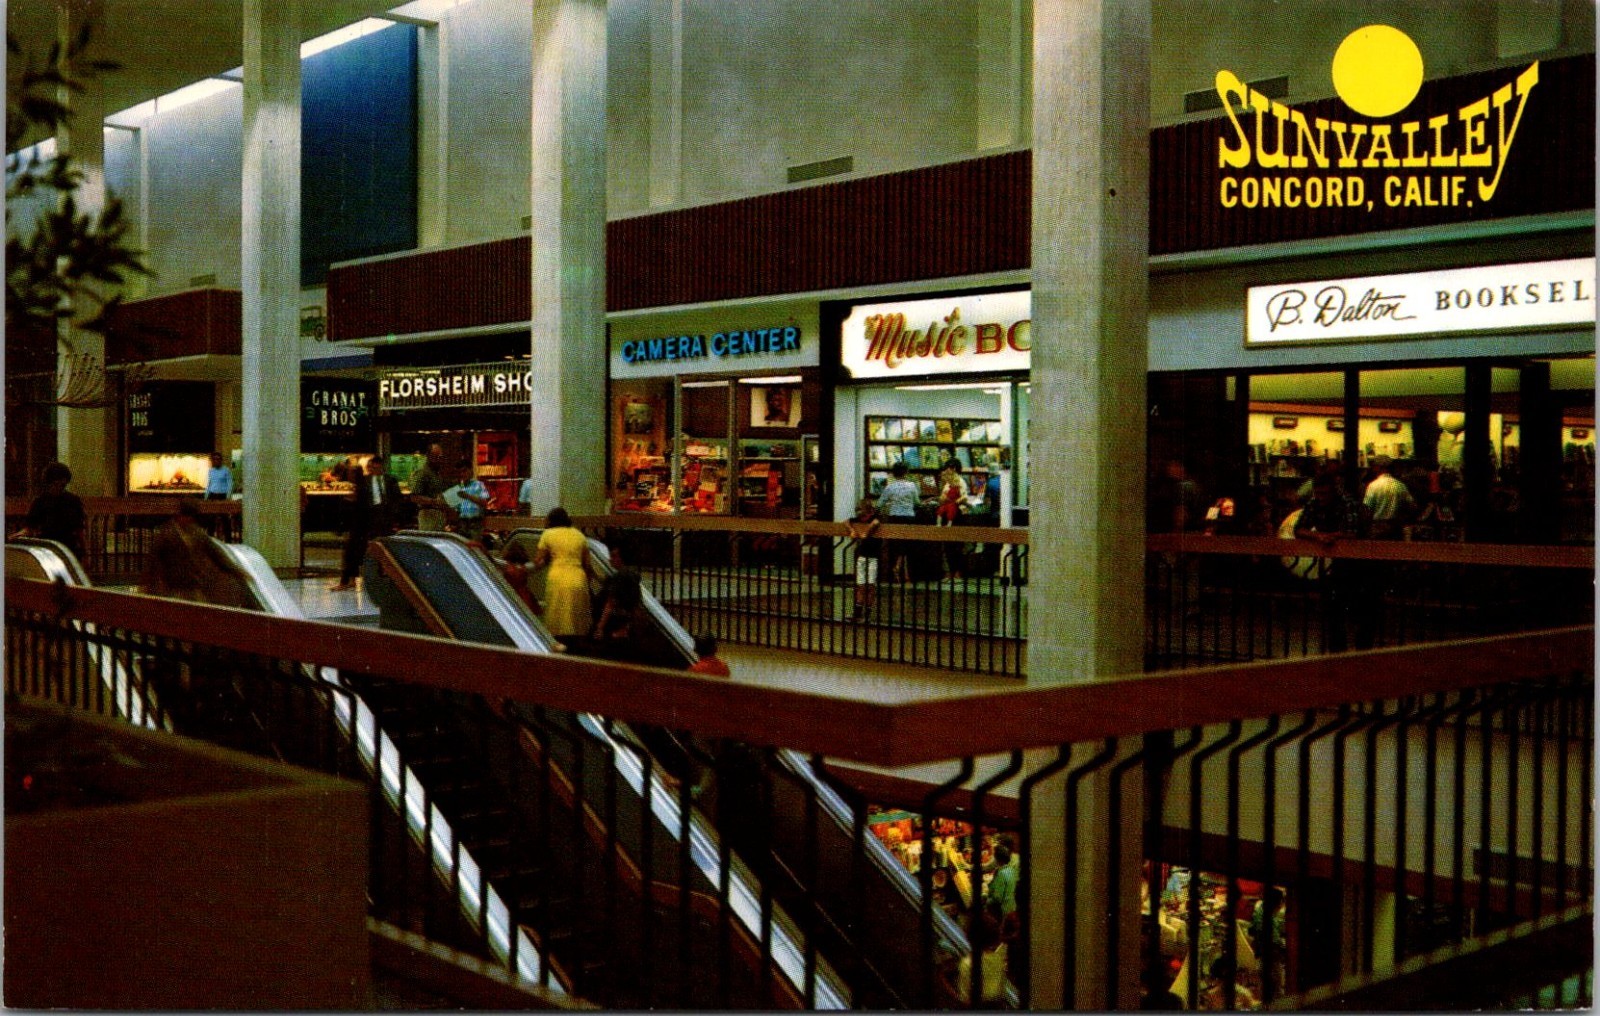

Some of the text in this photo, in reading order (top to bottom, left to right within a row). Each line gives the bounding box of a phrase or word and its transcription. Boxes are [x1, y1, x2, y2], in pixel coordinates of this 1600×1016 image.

[1266, 289, 1307, 332] B.
[1314, 286, 1417, 327] Dalton
[621, 326, 799, 363] CAMERA CENTER
[864, 307, 968, 369] Music
[312, 390, 366, 408] GRANAT
[380, 374, 485, 398] FLORSHEIM
[321, 410, 357, 426] BROS
